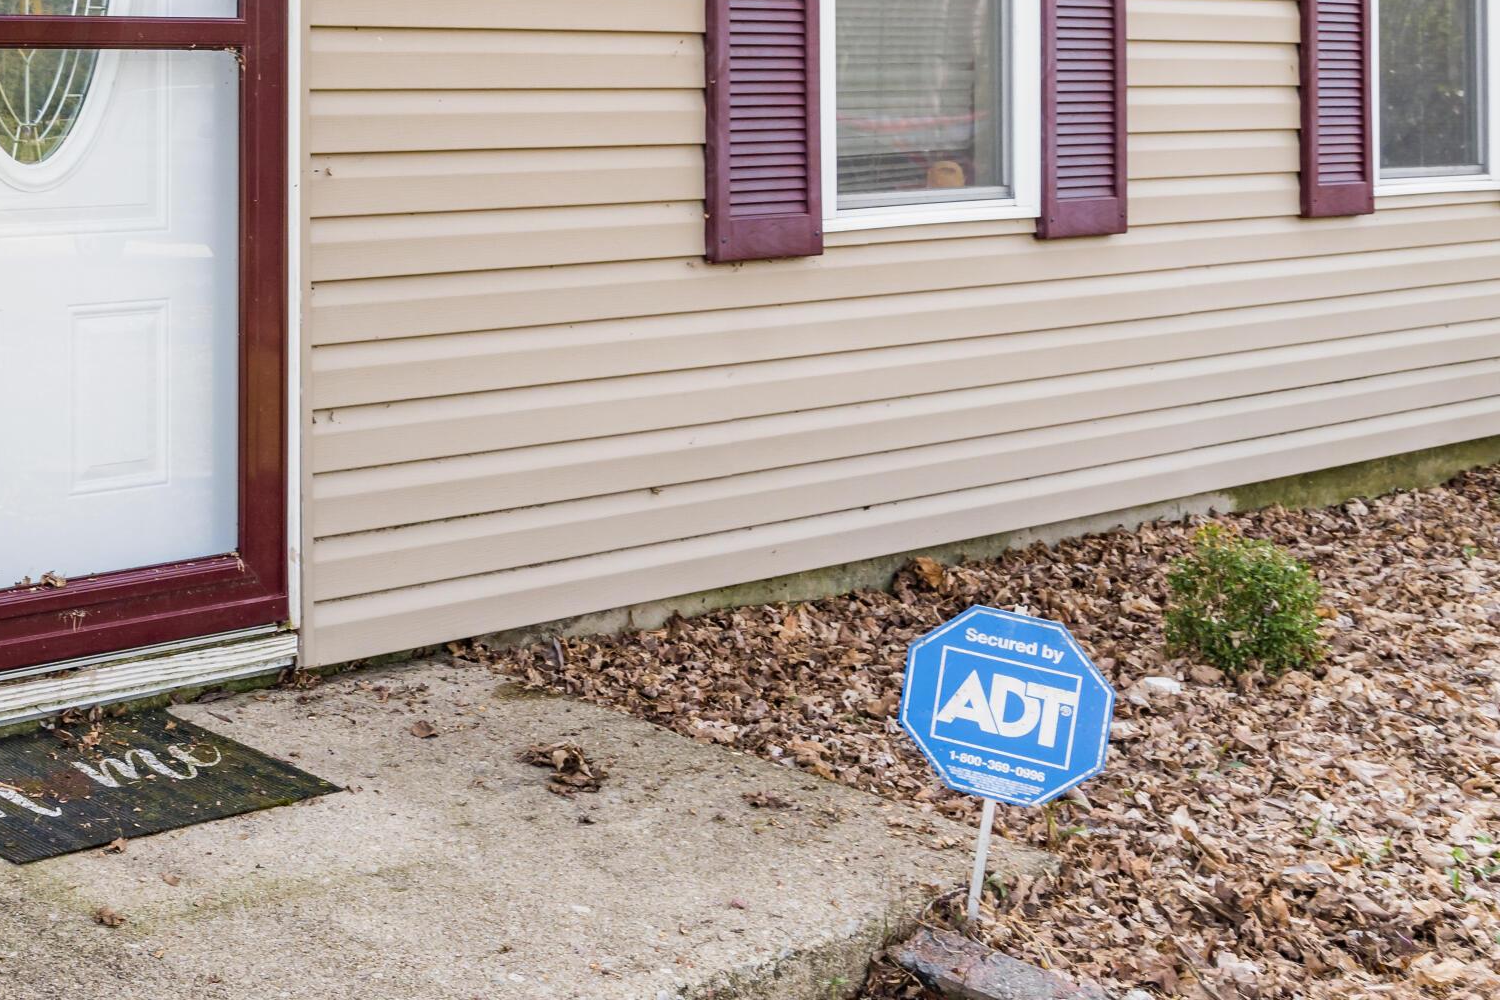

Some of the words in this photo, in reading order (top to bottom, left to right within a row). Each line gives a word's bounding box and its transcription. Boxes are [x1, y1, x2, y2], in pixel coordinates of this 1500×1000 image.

[964, 627, 1038, 659] Secured
[1042, 646, 1064, 664] by
[936, 669, 1078, 748] ADT
